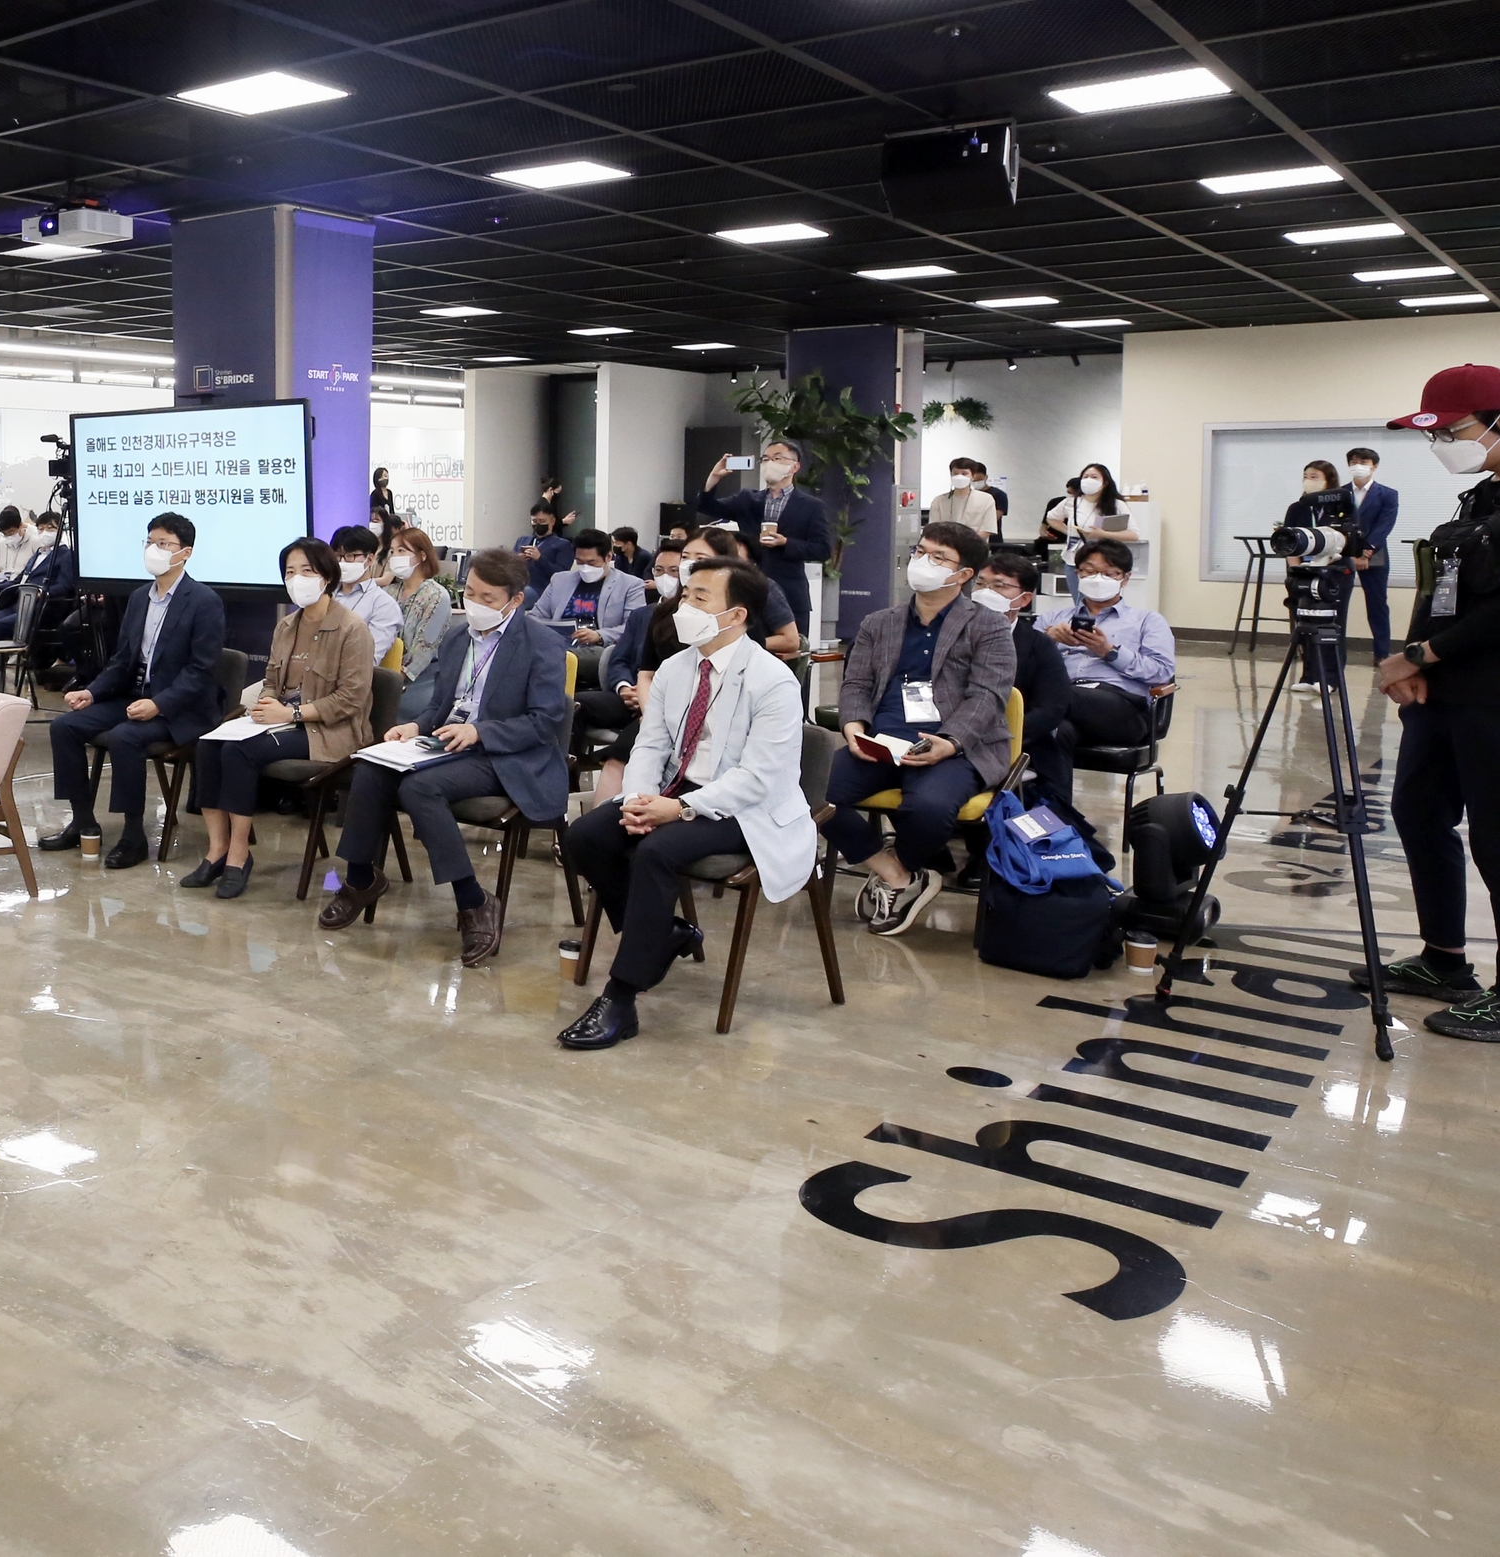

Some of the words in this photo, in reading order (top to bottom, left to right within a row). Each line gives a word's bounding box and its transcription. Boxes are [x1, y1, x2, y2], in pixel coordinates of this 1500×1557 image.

[307, 369, 329, 380] START
[342, 372, 359, 382] PARK
[85, 436, 117, 452] 올해도
[121, 430, 237, 451] 인천경제자유구역청은
[86, 463, 107, 479] 국내
[112, 463, 145, 478] 최고의
[151, 461, 208, 477] 스마트시티
[214, 459, 251, 476] 자원을
[257, 457, 297, 475] 활용한
[87, 490, 129, 506] 스타트업
[132, 490, 154, 505] 실증
[158, 489, 191, 505] 지원과
[194, 488, 255, 505] 행정지원을
[394, 490, 440, 511] create
[799, 928, 1395, 1321] Shinhan
